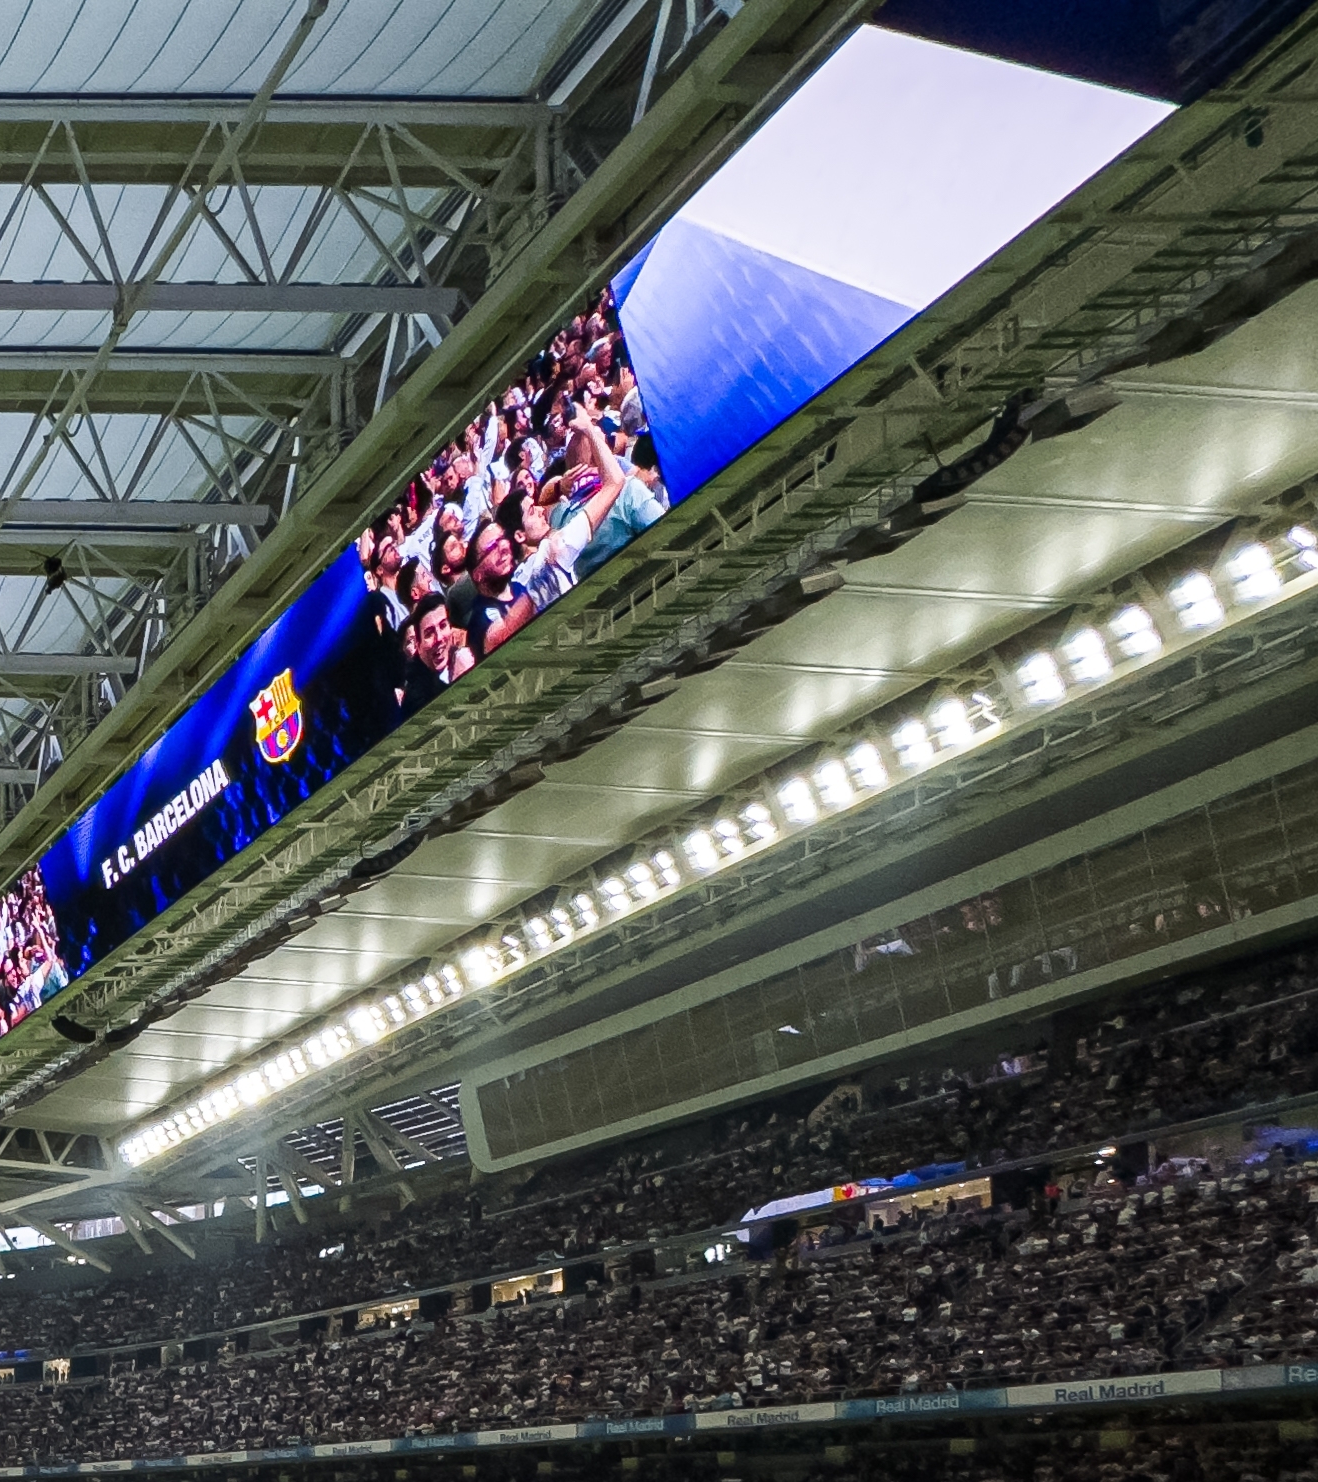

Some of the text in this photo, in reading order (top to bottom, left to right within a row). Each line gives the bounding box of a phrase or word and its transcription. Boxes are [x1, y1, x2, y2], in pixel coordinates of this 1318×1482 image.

[101, 758, 230, 889] F. C. BARCELONA
[1055, 1380, 1165, 1402] Real Madrid
[876, 1395, 960, 1413] Real Madrid
[727, 1410, 800, 1426] Real Madrid
